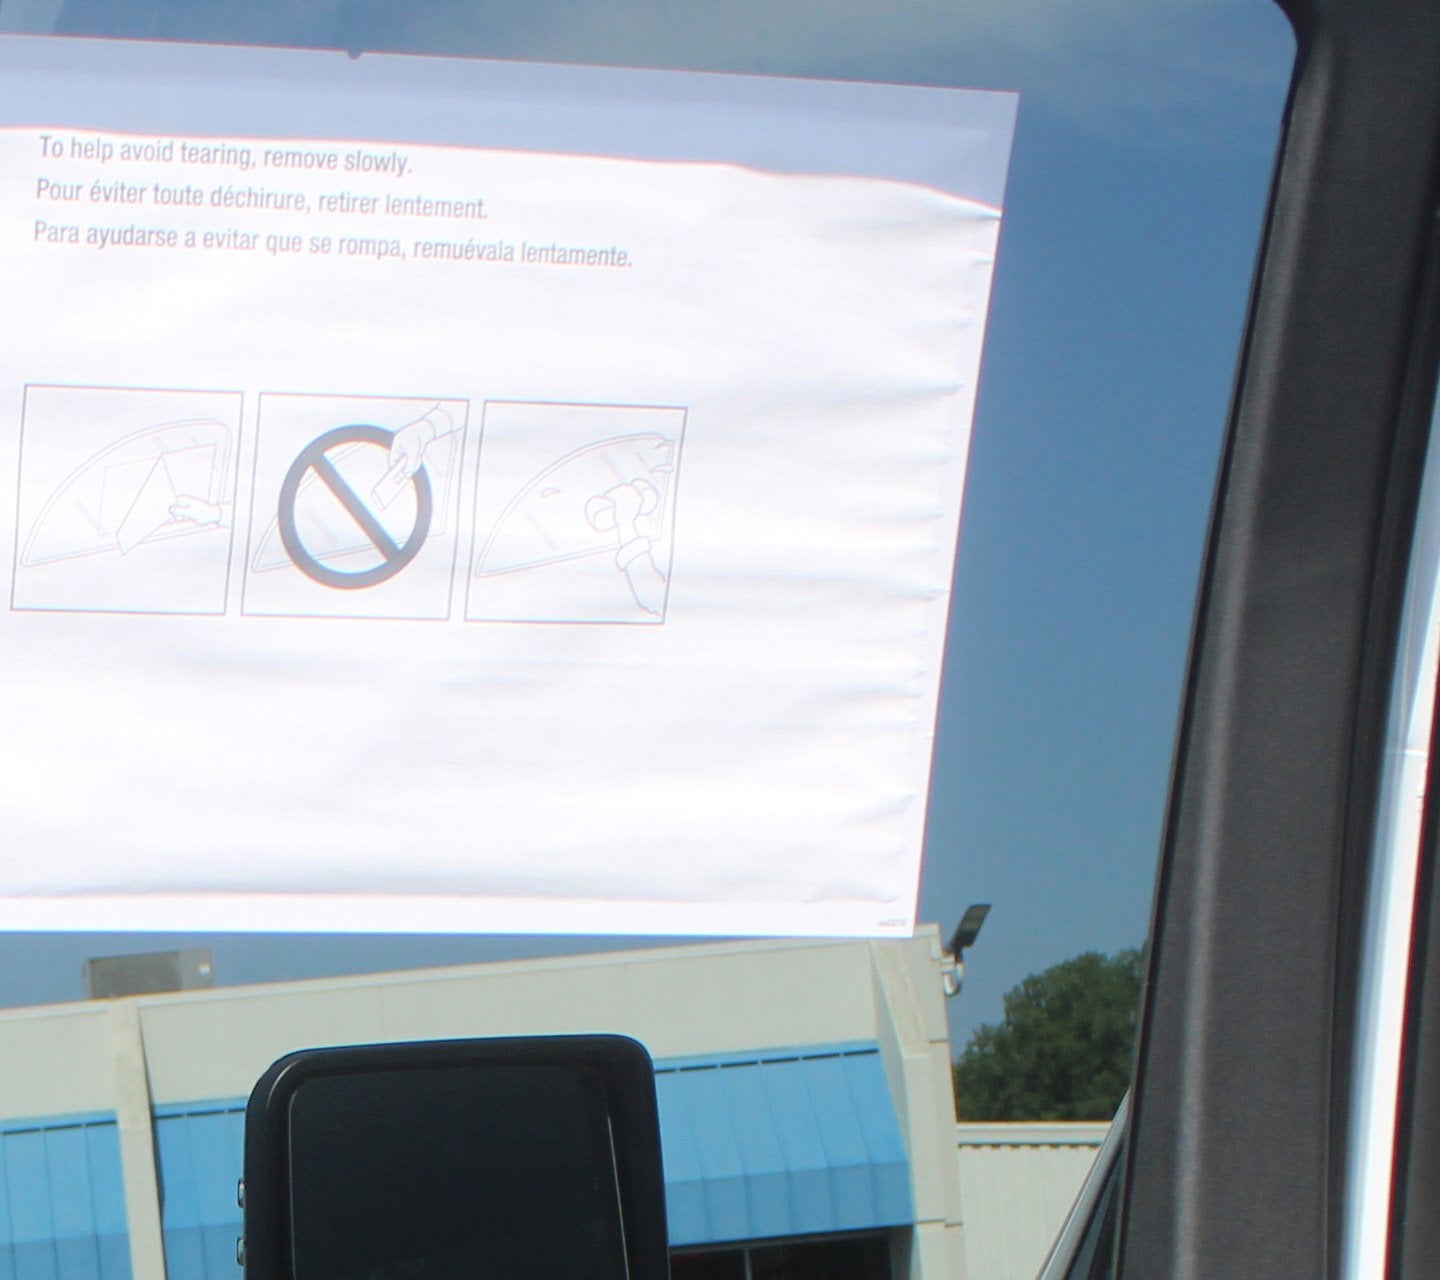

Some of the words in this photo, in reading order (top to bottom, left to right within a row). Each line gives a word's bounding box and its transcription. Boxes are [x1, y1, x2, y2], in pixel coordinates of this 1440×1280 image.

[40, 135, 64, 158] To
[70, 137, 114, 163] help
[120, 139, 174, 162] avoid
[181, 142, 257, 170] tearing,
[263, 149, 338, 170] remove
[344, 150, 413, 178] slowly.
[36, 178, 83, 201] Pour
[89, 179, 147, 204] éviter
[153, 182, 204, 206] toute
[210, 185, 312, 213] déchirure,
[318, 190, 379, 214] retirer
[385, 194, 488, 219] lentement.
[34, 220, 80, 243] Para
[86, 223, 178, 249] ayudarse
[184, 231, 196, 248] a
[203, 227, 260, 250] evitar
[265, 233, 303, 256] que
[309, 236, 332, 254] se
[338, 236, 406, 261] rompa,
[413, 238, 514, 262] remuévala
[520, 241, 633, 268] lentamente.
